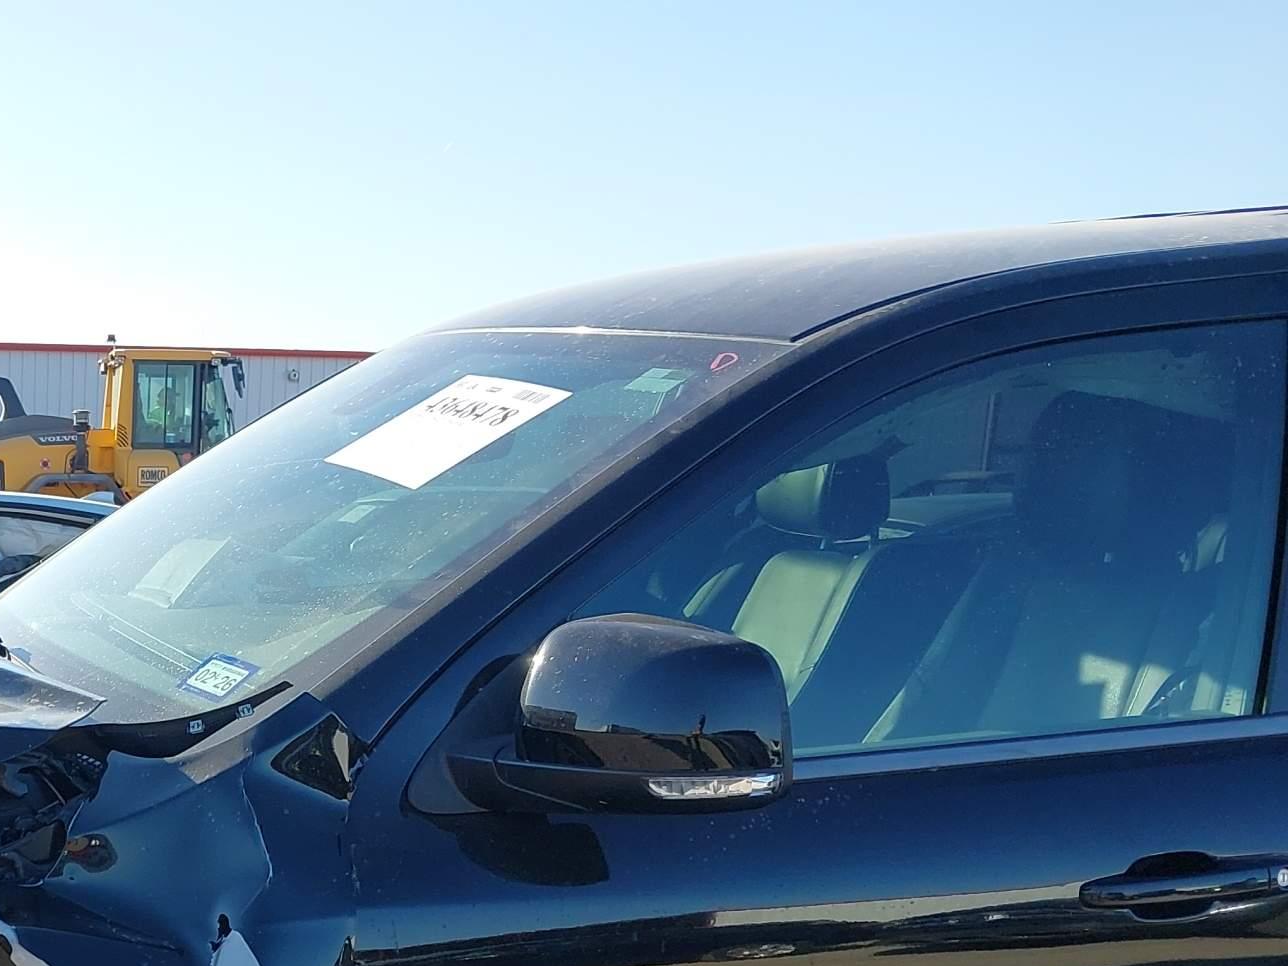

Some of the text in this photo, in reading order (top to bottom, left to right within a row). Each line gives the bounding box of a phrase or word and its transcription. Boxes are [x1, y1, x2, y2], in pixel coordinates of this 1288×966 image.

[425, 396, 520, 427] 43648478
[140, 469, 166, 480] ROMCO
[213, 675, 238, 692] 26
